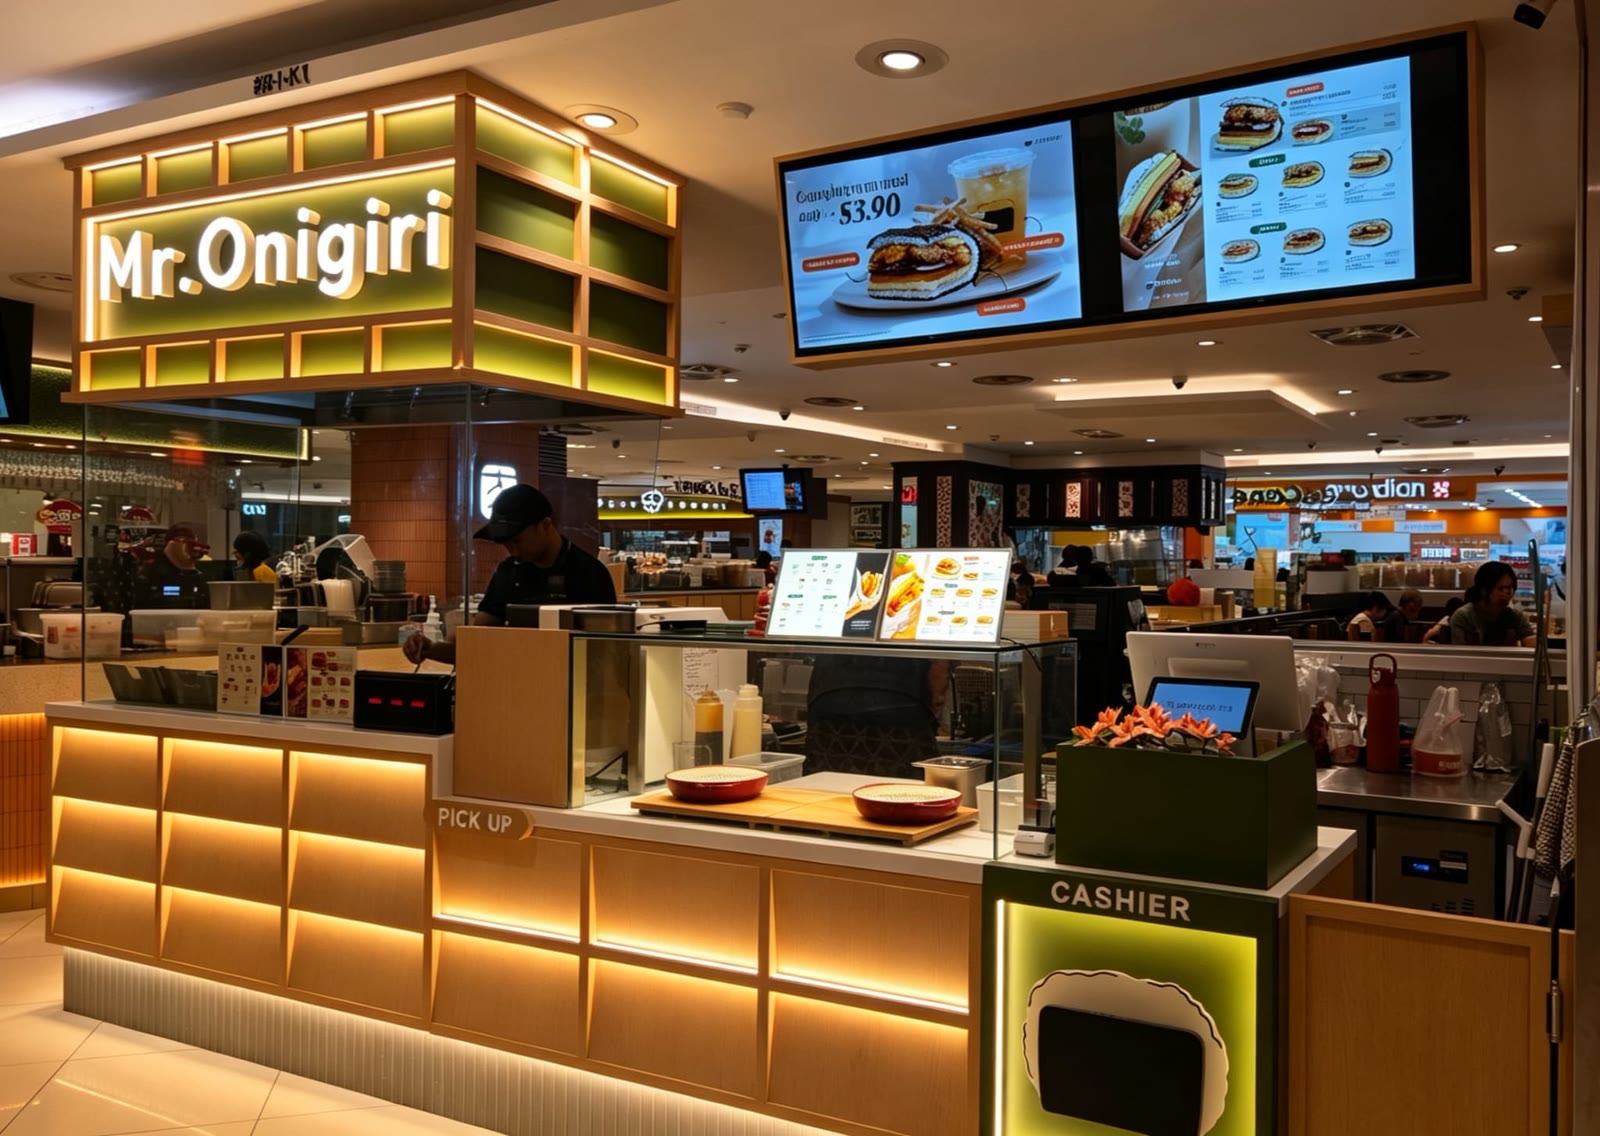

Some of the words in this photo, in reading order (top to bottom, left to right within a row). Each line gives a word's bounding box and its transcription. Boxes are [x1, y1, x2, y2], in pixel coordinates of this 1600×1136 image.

[438, 807, 480, 830] PICK
[487, 813, 513, 833] UP
[1050, 880, 1191, 922] CASHIER
